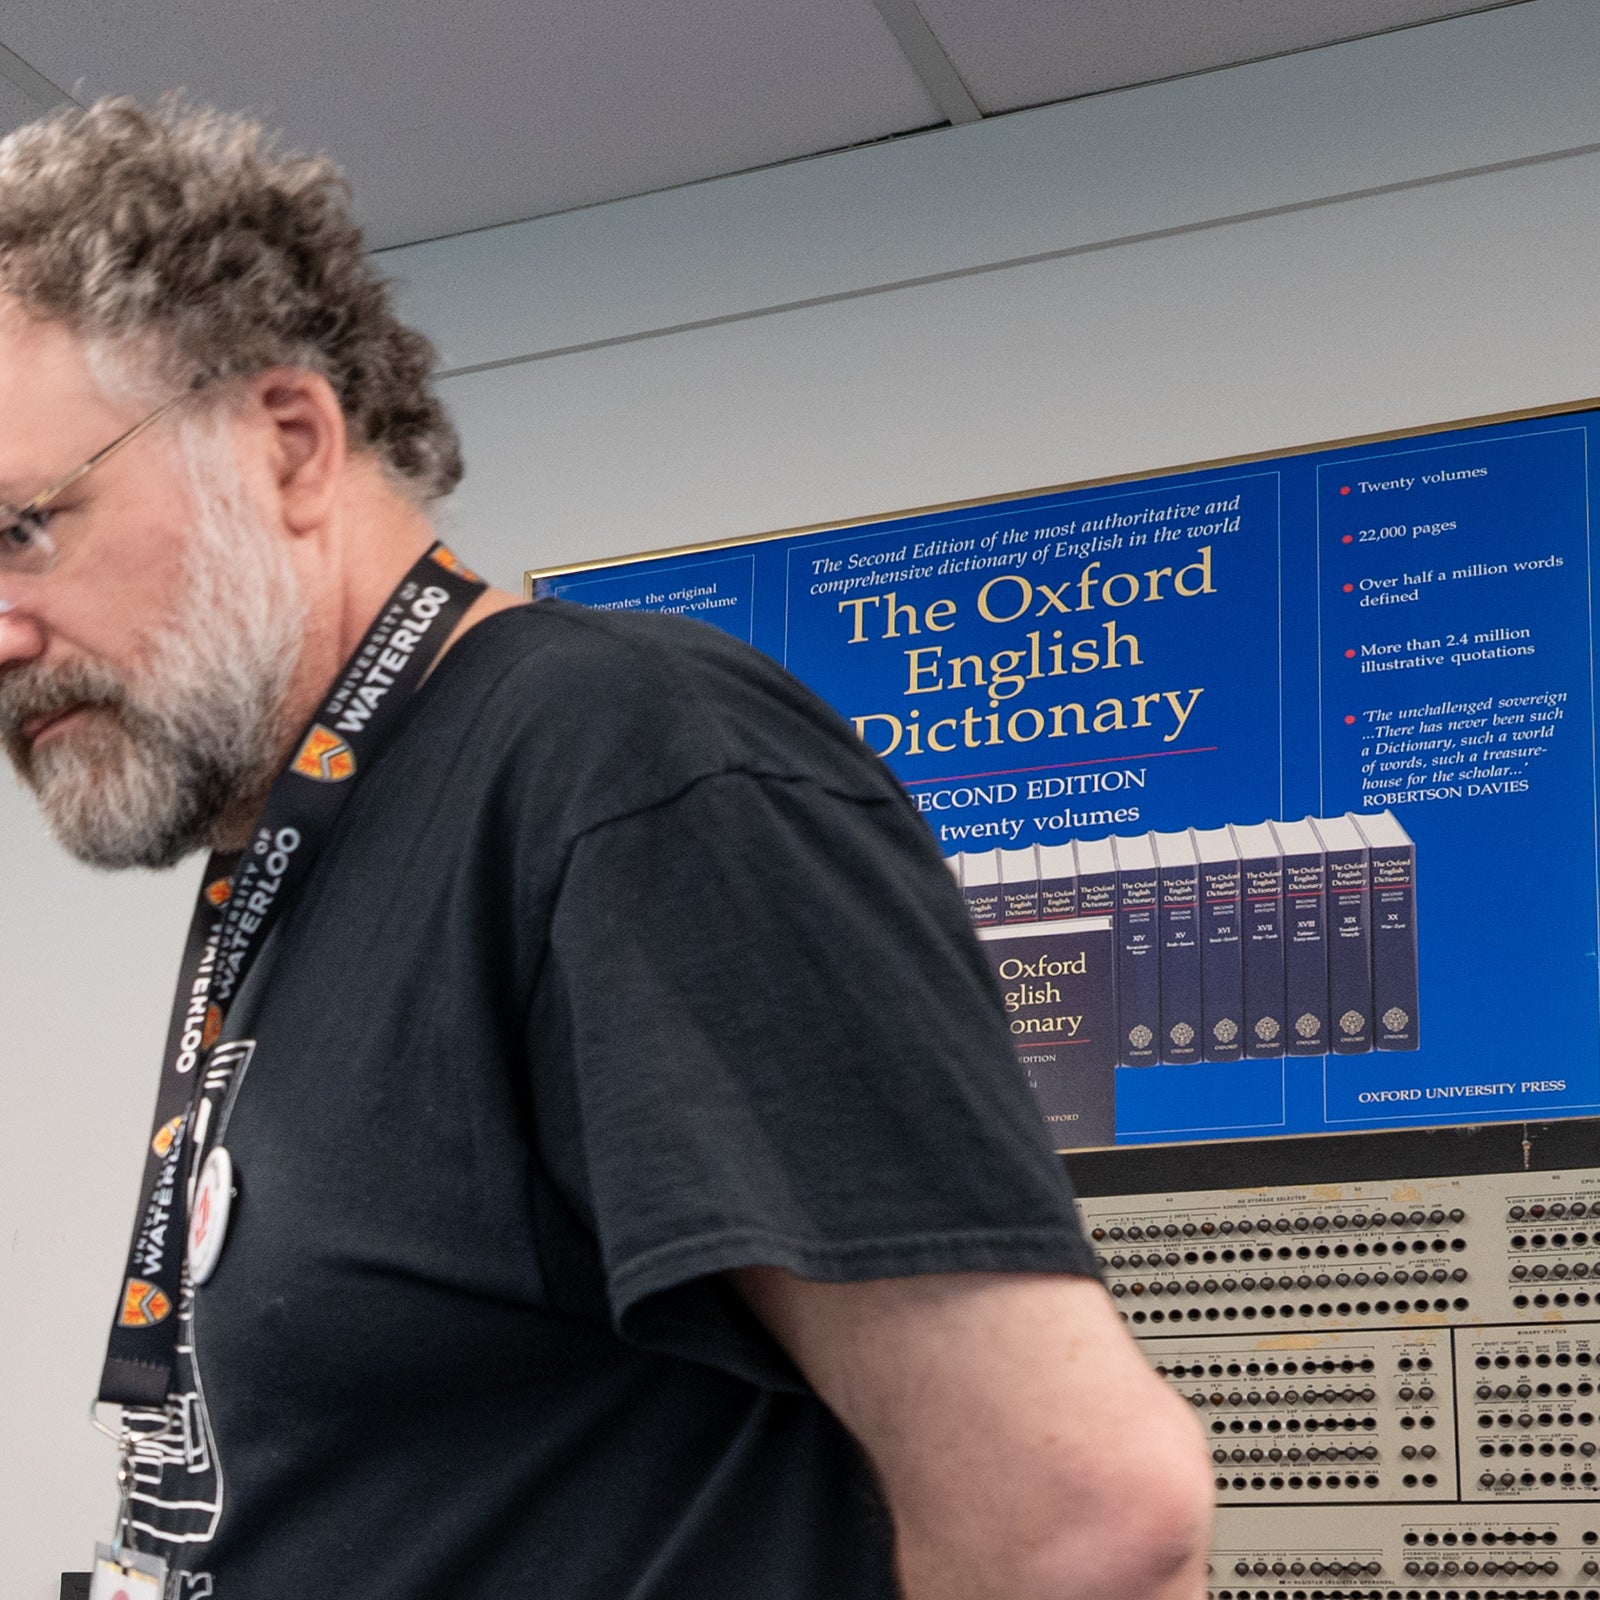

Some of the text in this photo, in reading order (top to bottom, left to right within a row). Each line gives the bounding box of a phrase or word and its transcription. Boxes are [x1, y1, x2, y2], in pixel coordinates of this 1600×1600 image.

[1358, 466, 1489, 495] Twenty volumes
[812, 495, 1240, 576] The Second Edition of the most authoritative and
[1358, 519, 1457, 543] 22,000 pages
[810, 516, 1240, 596] comprehensive dictionary of English in the world
[1359, 555, 1564, 591] Over half a million words
[645, 592, 665, 606] the
[668, 583, 718, 603] original
[838, 546, 1217, 644] The Oxford
[1360, 589, 1419, 608] defined
[1361, 627, 1531, 658] More than 2.4 million
[326, 604, 404, 714] UNIVERSITY
[335, 585, 450, 732] WATERLOO
[903, 621, 1144, 700] English
[1361, 644, 1535, 674] illustrative quotations
[1398, 697, 1492, 719] unchallenged
[1497, 690, 1568, 709] sovereign
[851, 687, 1204, 758] Dictionary
[1419, 720, 1443, 734] has
[1448, 716, 1488, 730] never
[1492, 712, 1525, 727] been
[1529, 708, 1564, 722] such
[1361, 725, 1555, 757] a Dictionary, such a world
[1361, 744, 1548, 776] of words, such a treasure-
[1026, 768, 1147, 801] EDITION
[1362, 776, 1403, 790] house
[1405, 772, 1428, 789] for
[1432, 770, 1454, 784] the
[1363, 780, 1529, 807] ROBERTSON DAVIES
[939, 807, 1140, 842] twenty volumes
[218, 827, 300, 1000] WATERLOO
[999, 952, 1087, 980] Oxford
[1004, 982, 1061, 1013] glish
[1358, 1079, 1566, 1104] OXFORD UNIVERSITY PRESS
